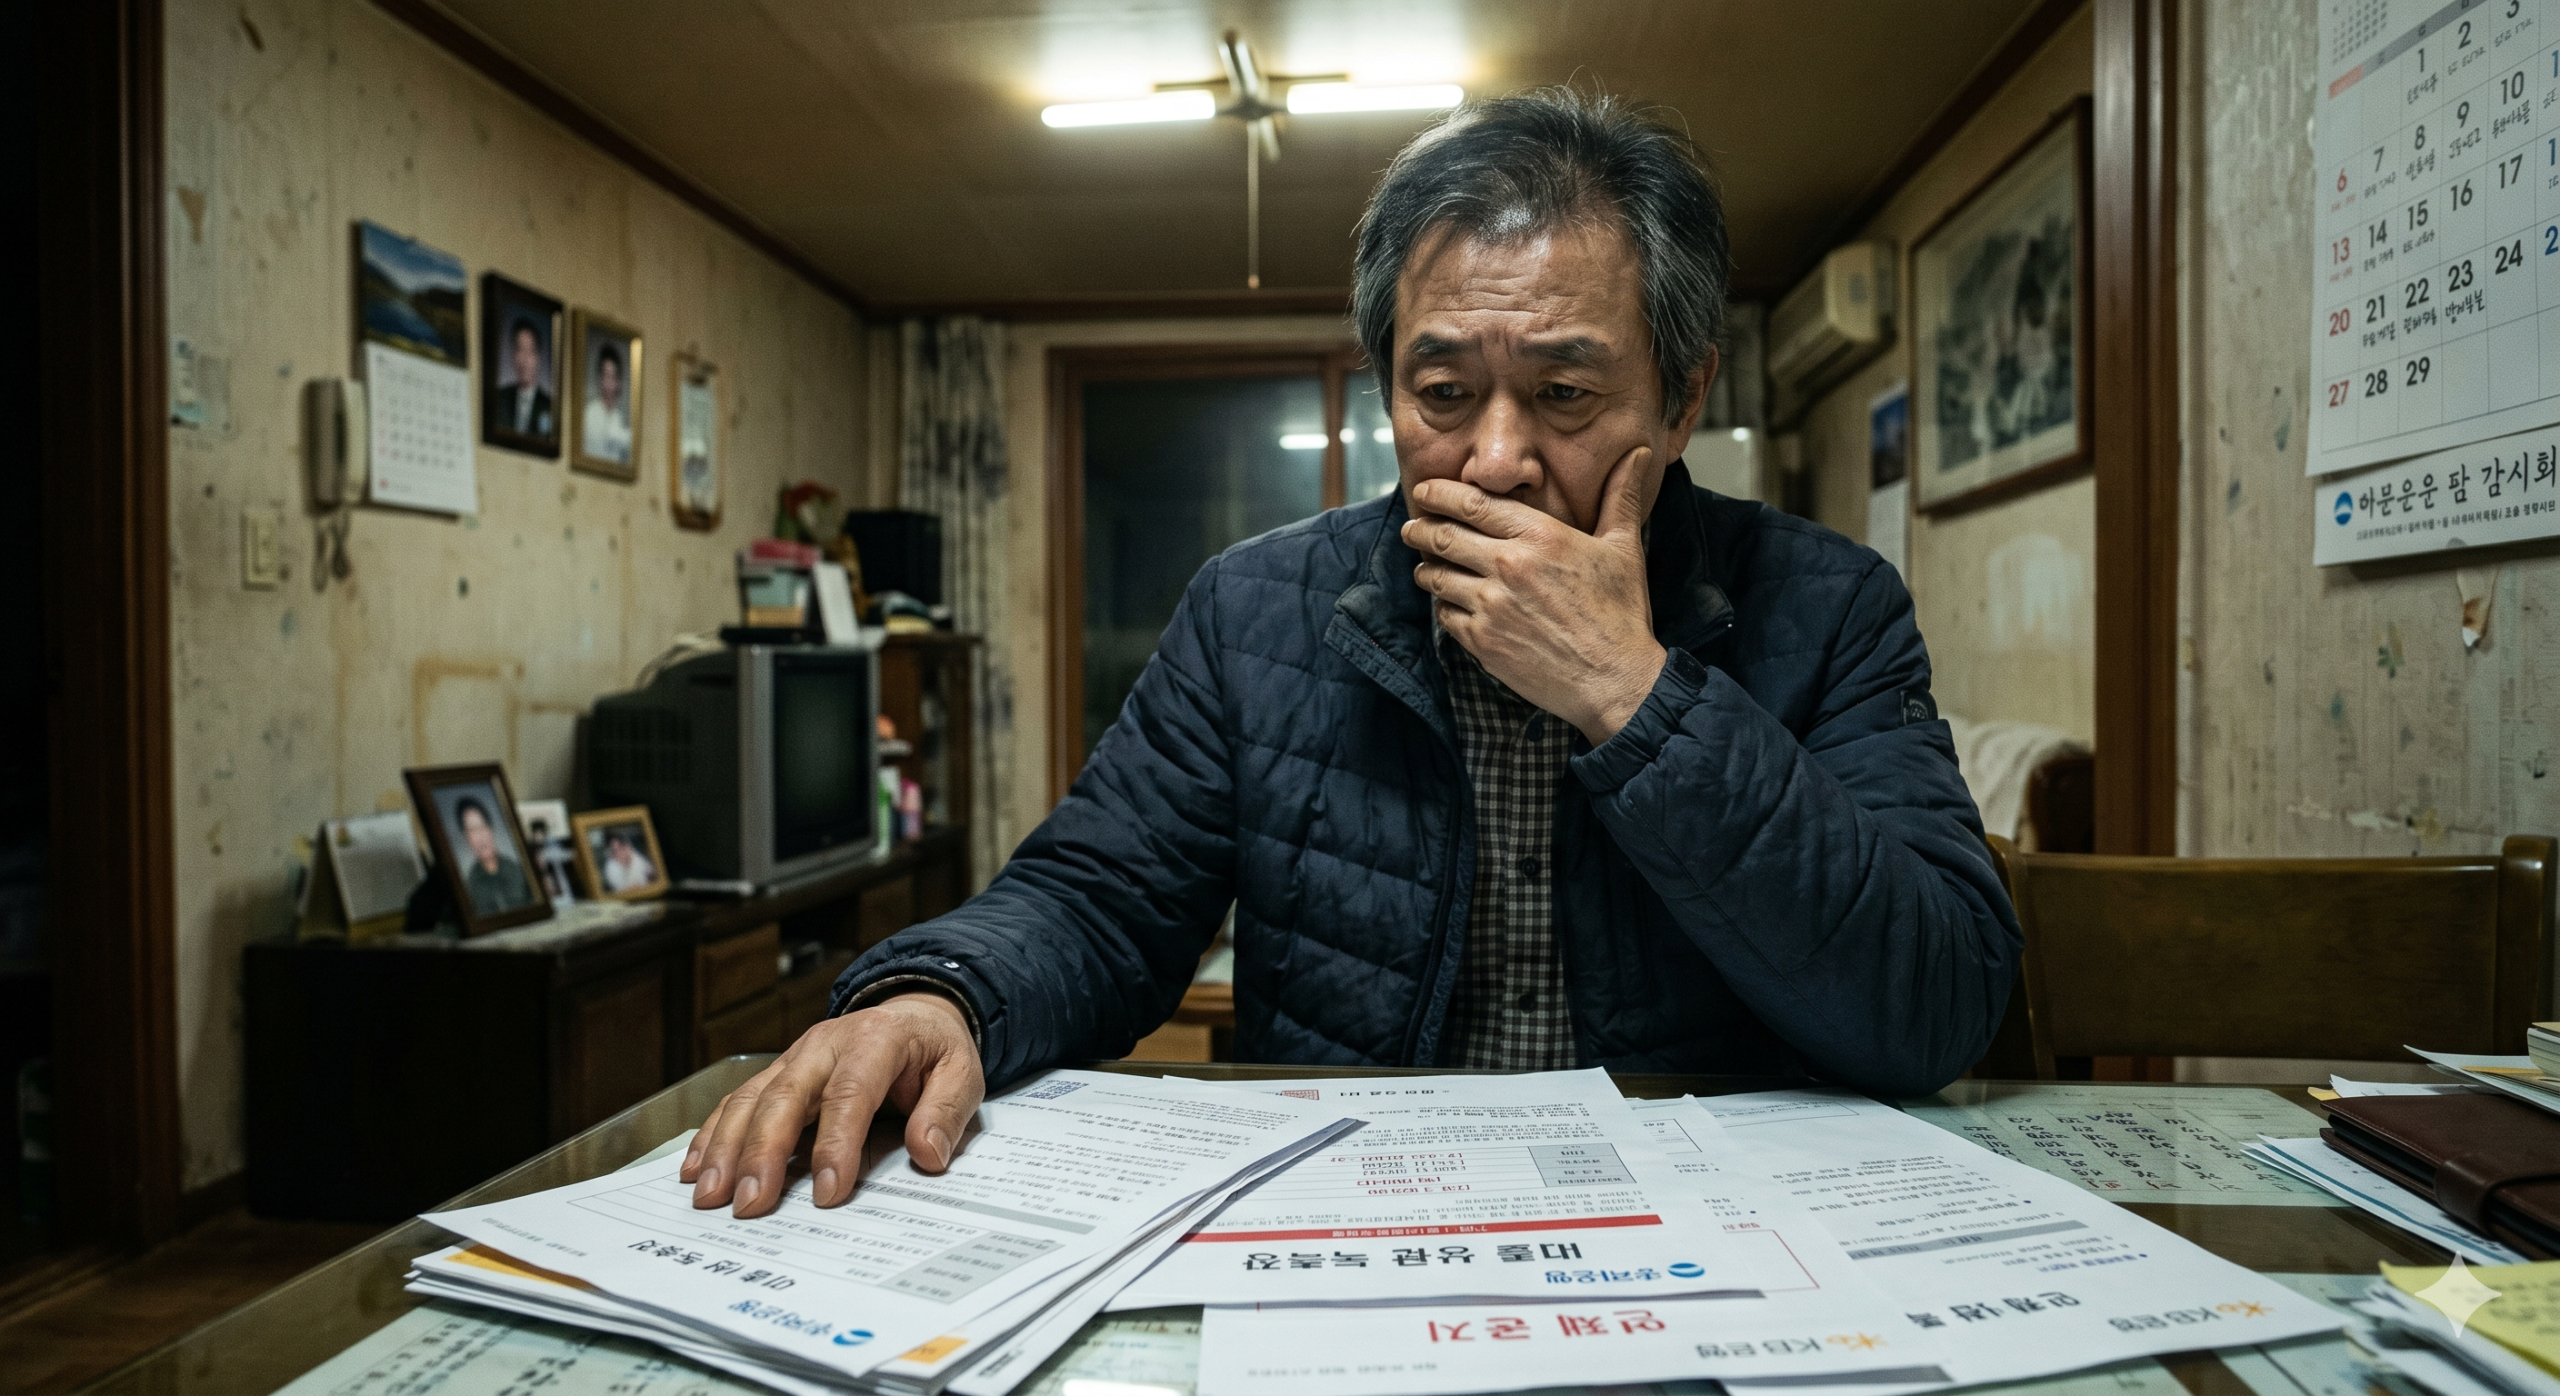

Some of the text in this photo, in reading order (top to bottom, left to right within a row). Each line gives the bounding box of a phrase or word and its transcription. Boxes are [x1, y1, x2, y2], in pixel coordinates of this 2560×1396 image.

[2418, 48, 2424, 73] 1
[2458, 21, 2471, 50] 2
[2506, 0, 2519, 19] 3
[2337, 167, 2347, 192] 6
[2374, 146, 2385, 172] 7
[2414, 124, 2425, 150] 8
[2456, 101, 2470, 128] 9
[2501, 71, 2524, 105] 10
[2332, 236, 2350, 265] 13
[2368, 219, 2388, 248] 14
[2408, 199, 2428, 231] 15
[2450, 178, 2473, 212] 16
[2499, 153, 2523, 190] 17
[2329, 307, 2350, 336] 20
[2366, 294, 2385, 324] 21
[2405, 278, 2430, 309] 22
[2448, 259, 2474, 293] 23
[2495, 239, 2523, 275] 24
[2329, 356, 2431, 408] 27 28 29
[2448, 463, 2470, 504] 팜
[2480, 444, 2557, 498] 감시회
